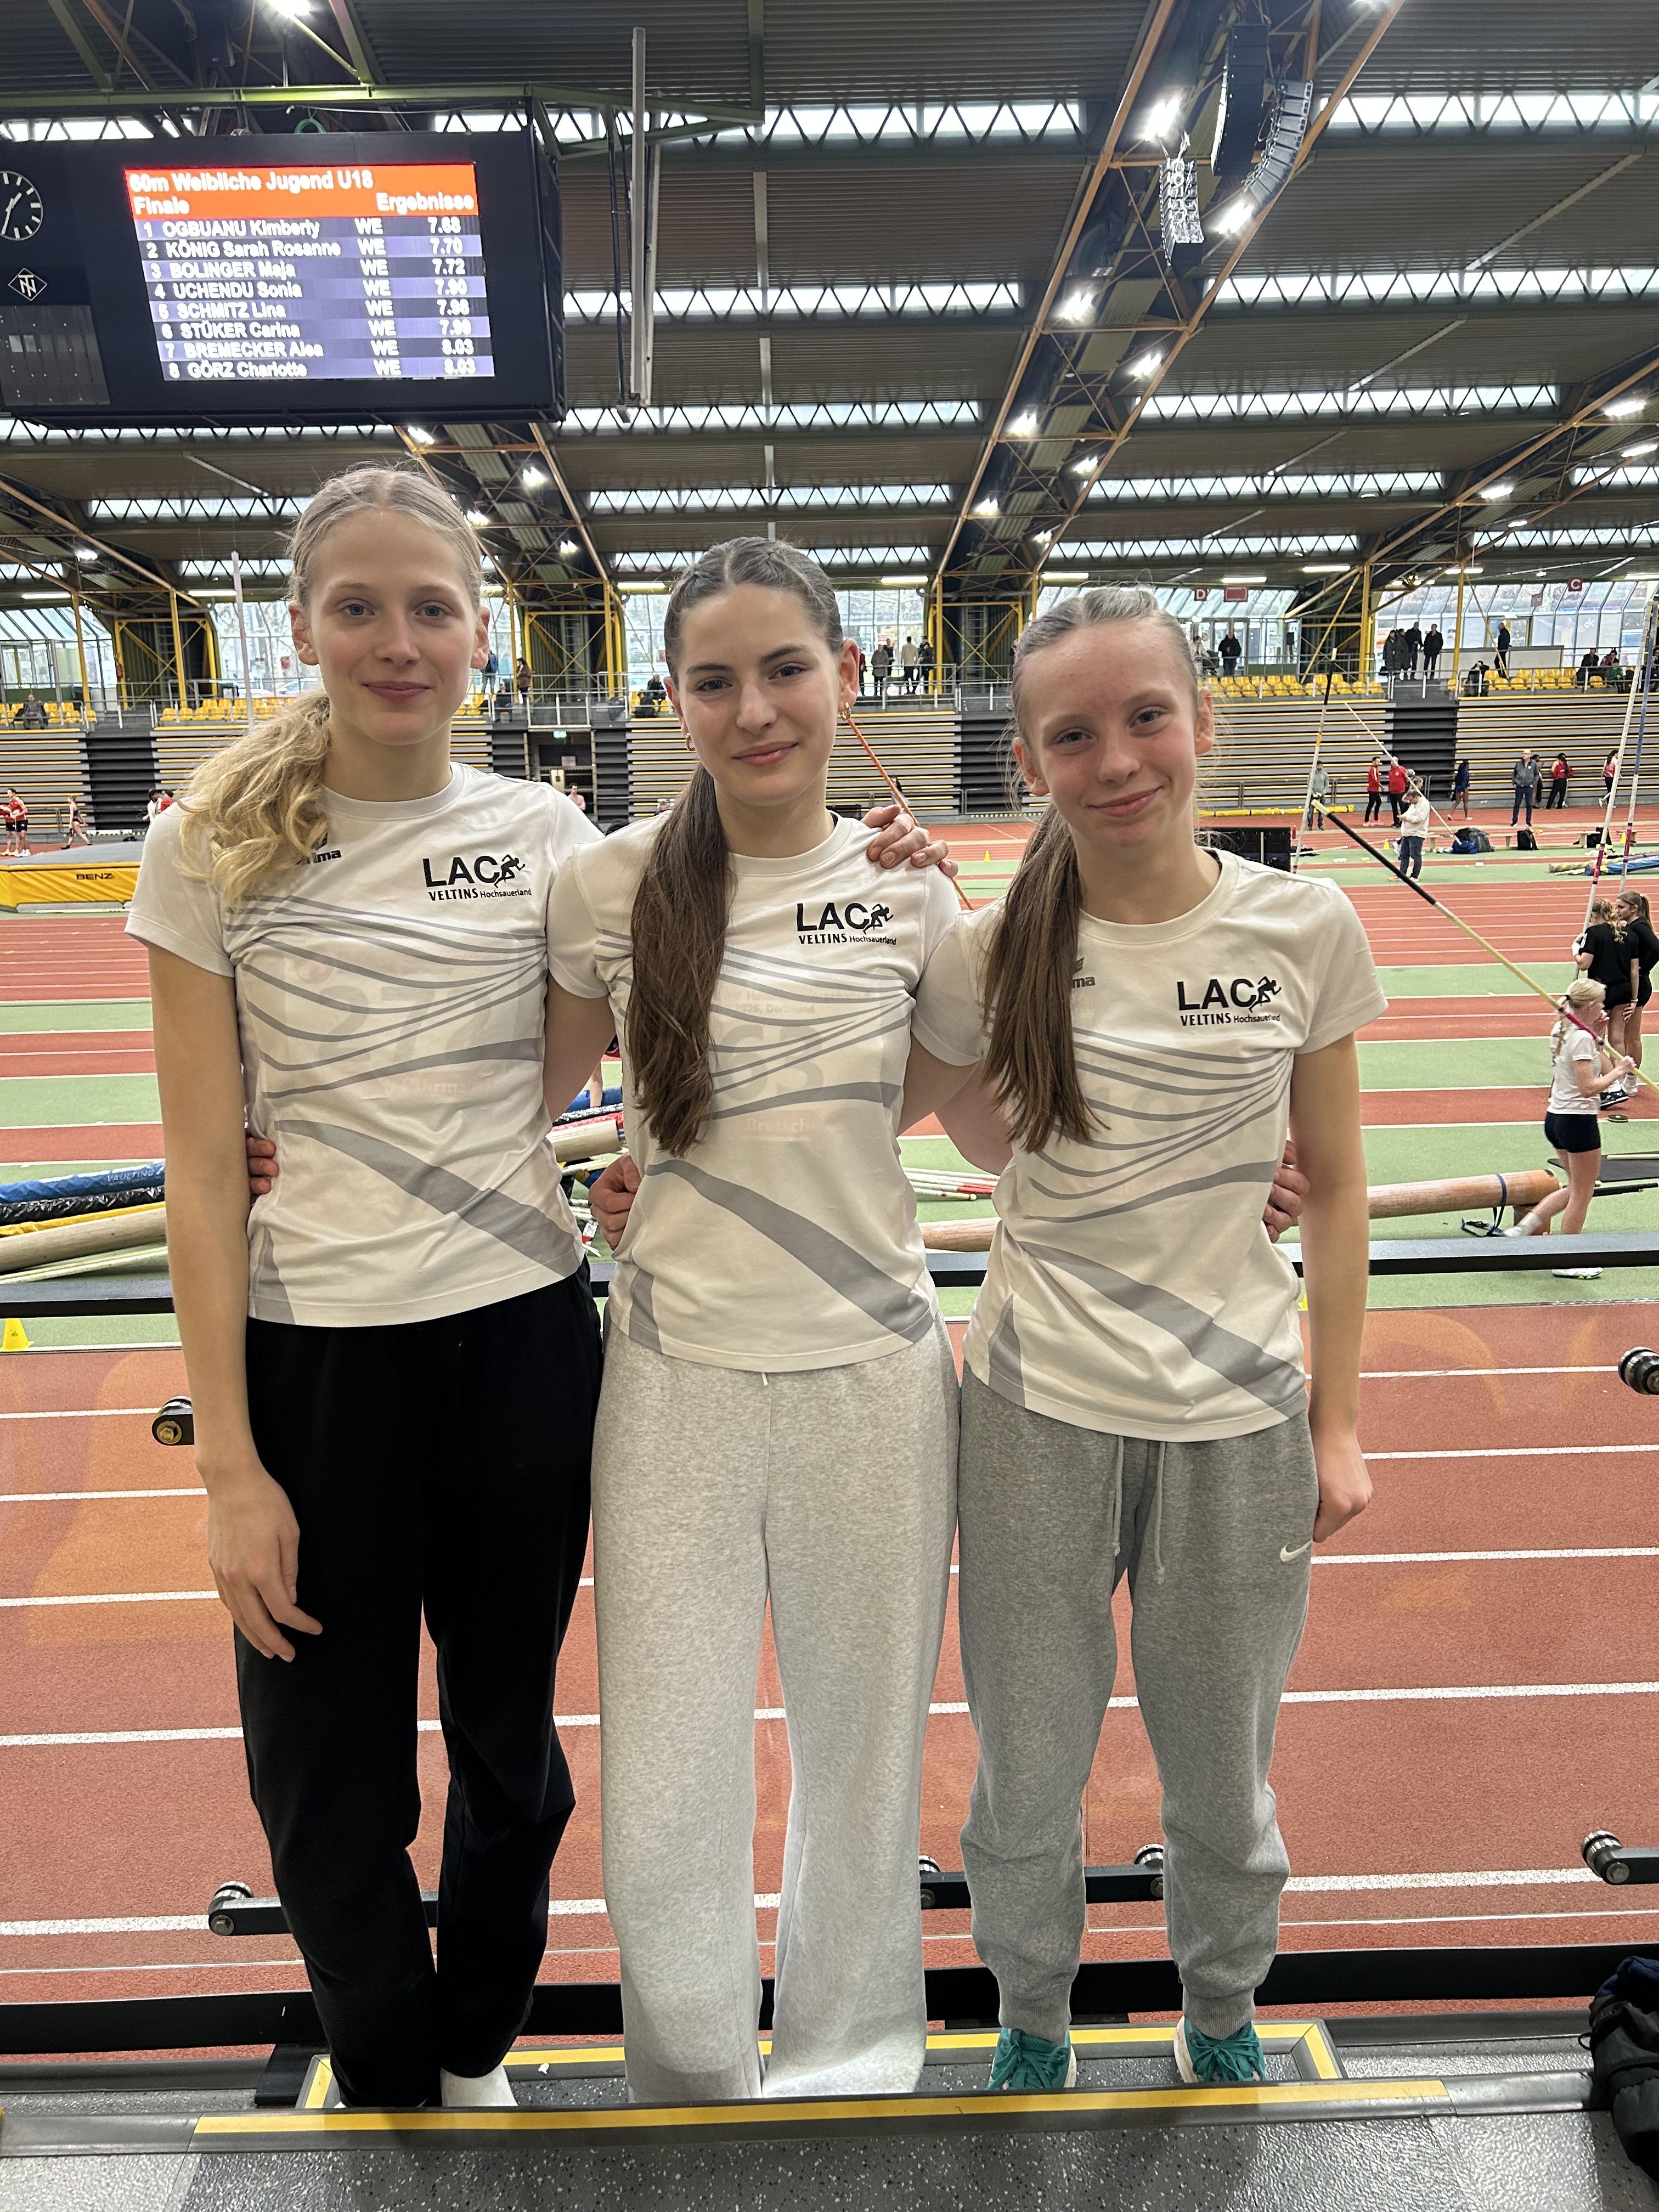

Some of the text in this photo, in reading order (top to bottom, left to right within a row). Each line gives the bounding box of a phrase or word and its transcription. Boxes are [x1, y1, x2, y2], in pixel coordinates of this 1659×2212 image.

[129, 170, 373, 193] 60m Weibliche Jugend U18
[134, 193, 473, 215] Finale Ergebnisse
[143, 221, 153, 238] 1
[162, 220, 247, 238] OGBUANU
[250, 219, 320, 239] Kimberly
[354, 218, 383, 235] WE
[146, 237, 463, 258] 2 KÖNIG Sarah Rosanne WE 7.70
[150, 258, 466, 281] 3 BOLINGER Maja WE 7.72
[154, 283, 166, 299] 4
[172, 281, 254, 299] UCHENDU
[257, 281, 302, 298] Sonia
[362, 279, 391, 296] WE
[159, 303, 169, 319] 5
[177, 302, 250, 319] SCHMITZ
[251, 301, 286, 318] Lina
[365, 300, 394, 317] WE
[161, 323, 173, 339] 6
[180, 320, 248, 339] STÜKER
[249, 321, 301, 338] Carina
[368, 320, 397, 336] WE
[165, 343, 175, 359] 7
[183, 341, 287, 359] BREMECKER
[370, 340, 399, 356] WE
[442, 338, 474, 355] 8.03
[168, 358, 476, 379] 8 GÖRZ Charlotte WE 8.03
[1570, 578, 1581, 590] C
[422, 855, 500, 887] LAC
[428, 888, 532, 901] VELTINS Hochsauerland
[797, 902, 870, 932] LAC
[798, 933, 897, 945] VELTINS Hochsauerland
[1177, 978, 1257, 1011] LAC
[1180, 1013, 1231, 1026] VELTINS
